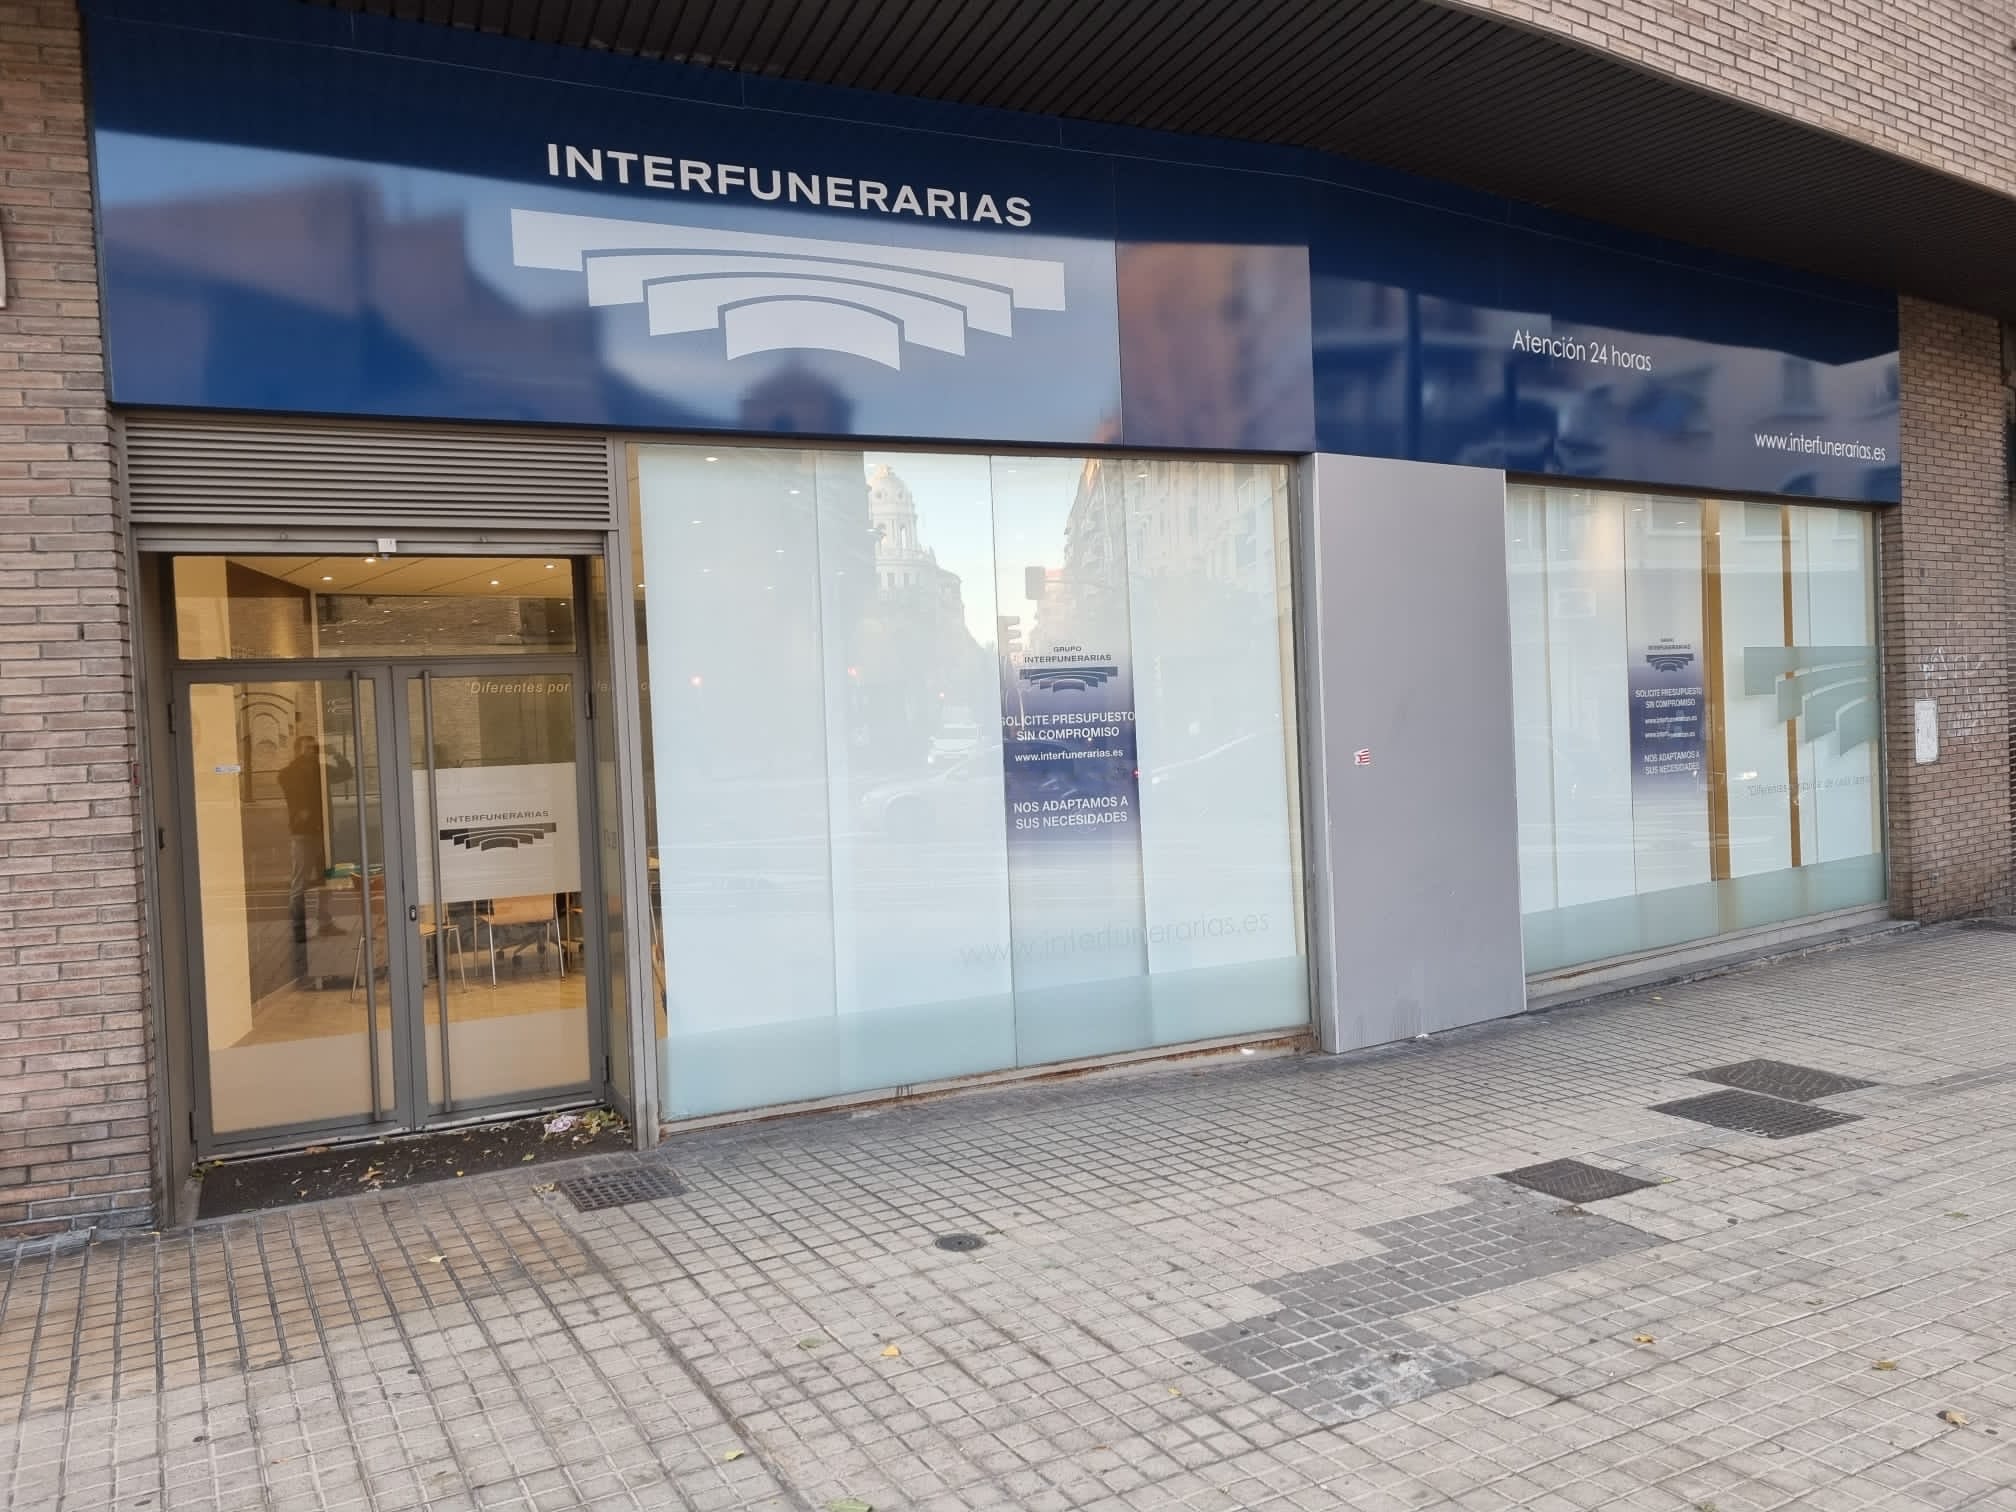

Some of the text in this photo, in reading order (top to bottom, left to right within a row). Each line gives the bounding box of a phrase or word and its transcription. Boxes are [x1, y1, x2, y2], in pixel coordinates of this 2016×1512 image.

[547, 143, 1033, 228] INTERFUNERARIAS
[1512, 328, 1652, 372] Atención 24 horas
[1754, 430, 1887, 462] www.interfunerarias.es
[1024, 653, 1112, 664] INTERFUNERARIAS
[547, 682, 569, 696] por
[1052, 711, 1136, 725] PRESUPUESTO
[1016, 726, 1120, 741] SIN COMPROMISO
[1015, 748, 1123, 763] www.interfunerarias.es
[1013, 796, 1129, 814] NOS ADAPTAMOS A
[446, 810, 550, 824] INTERFUNERARIAS
[1016, 811, 1128, 830] SUS NECESIDADES
